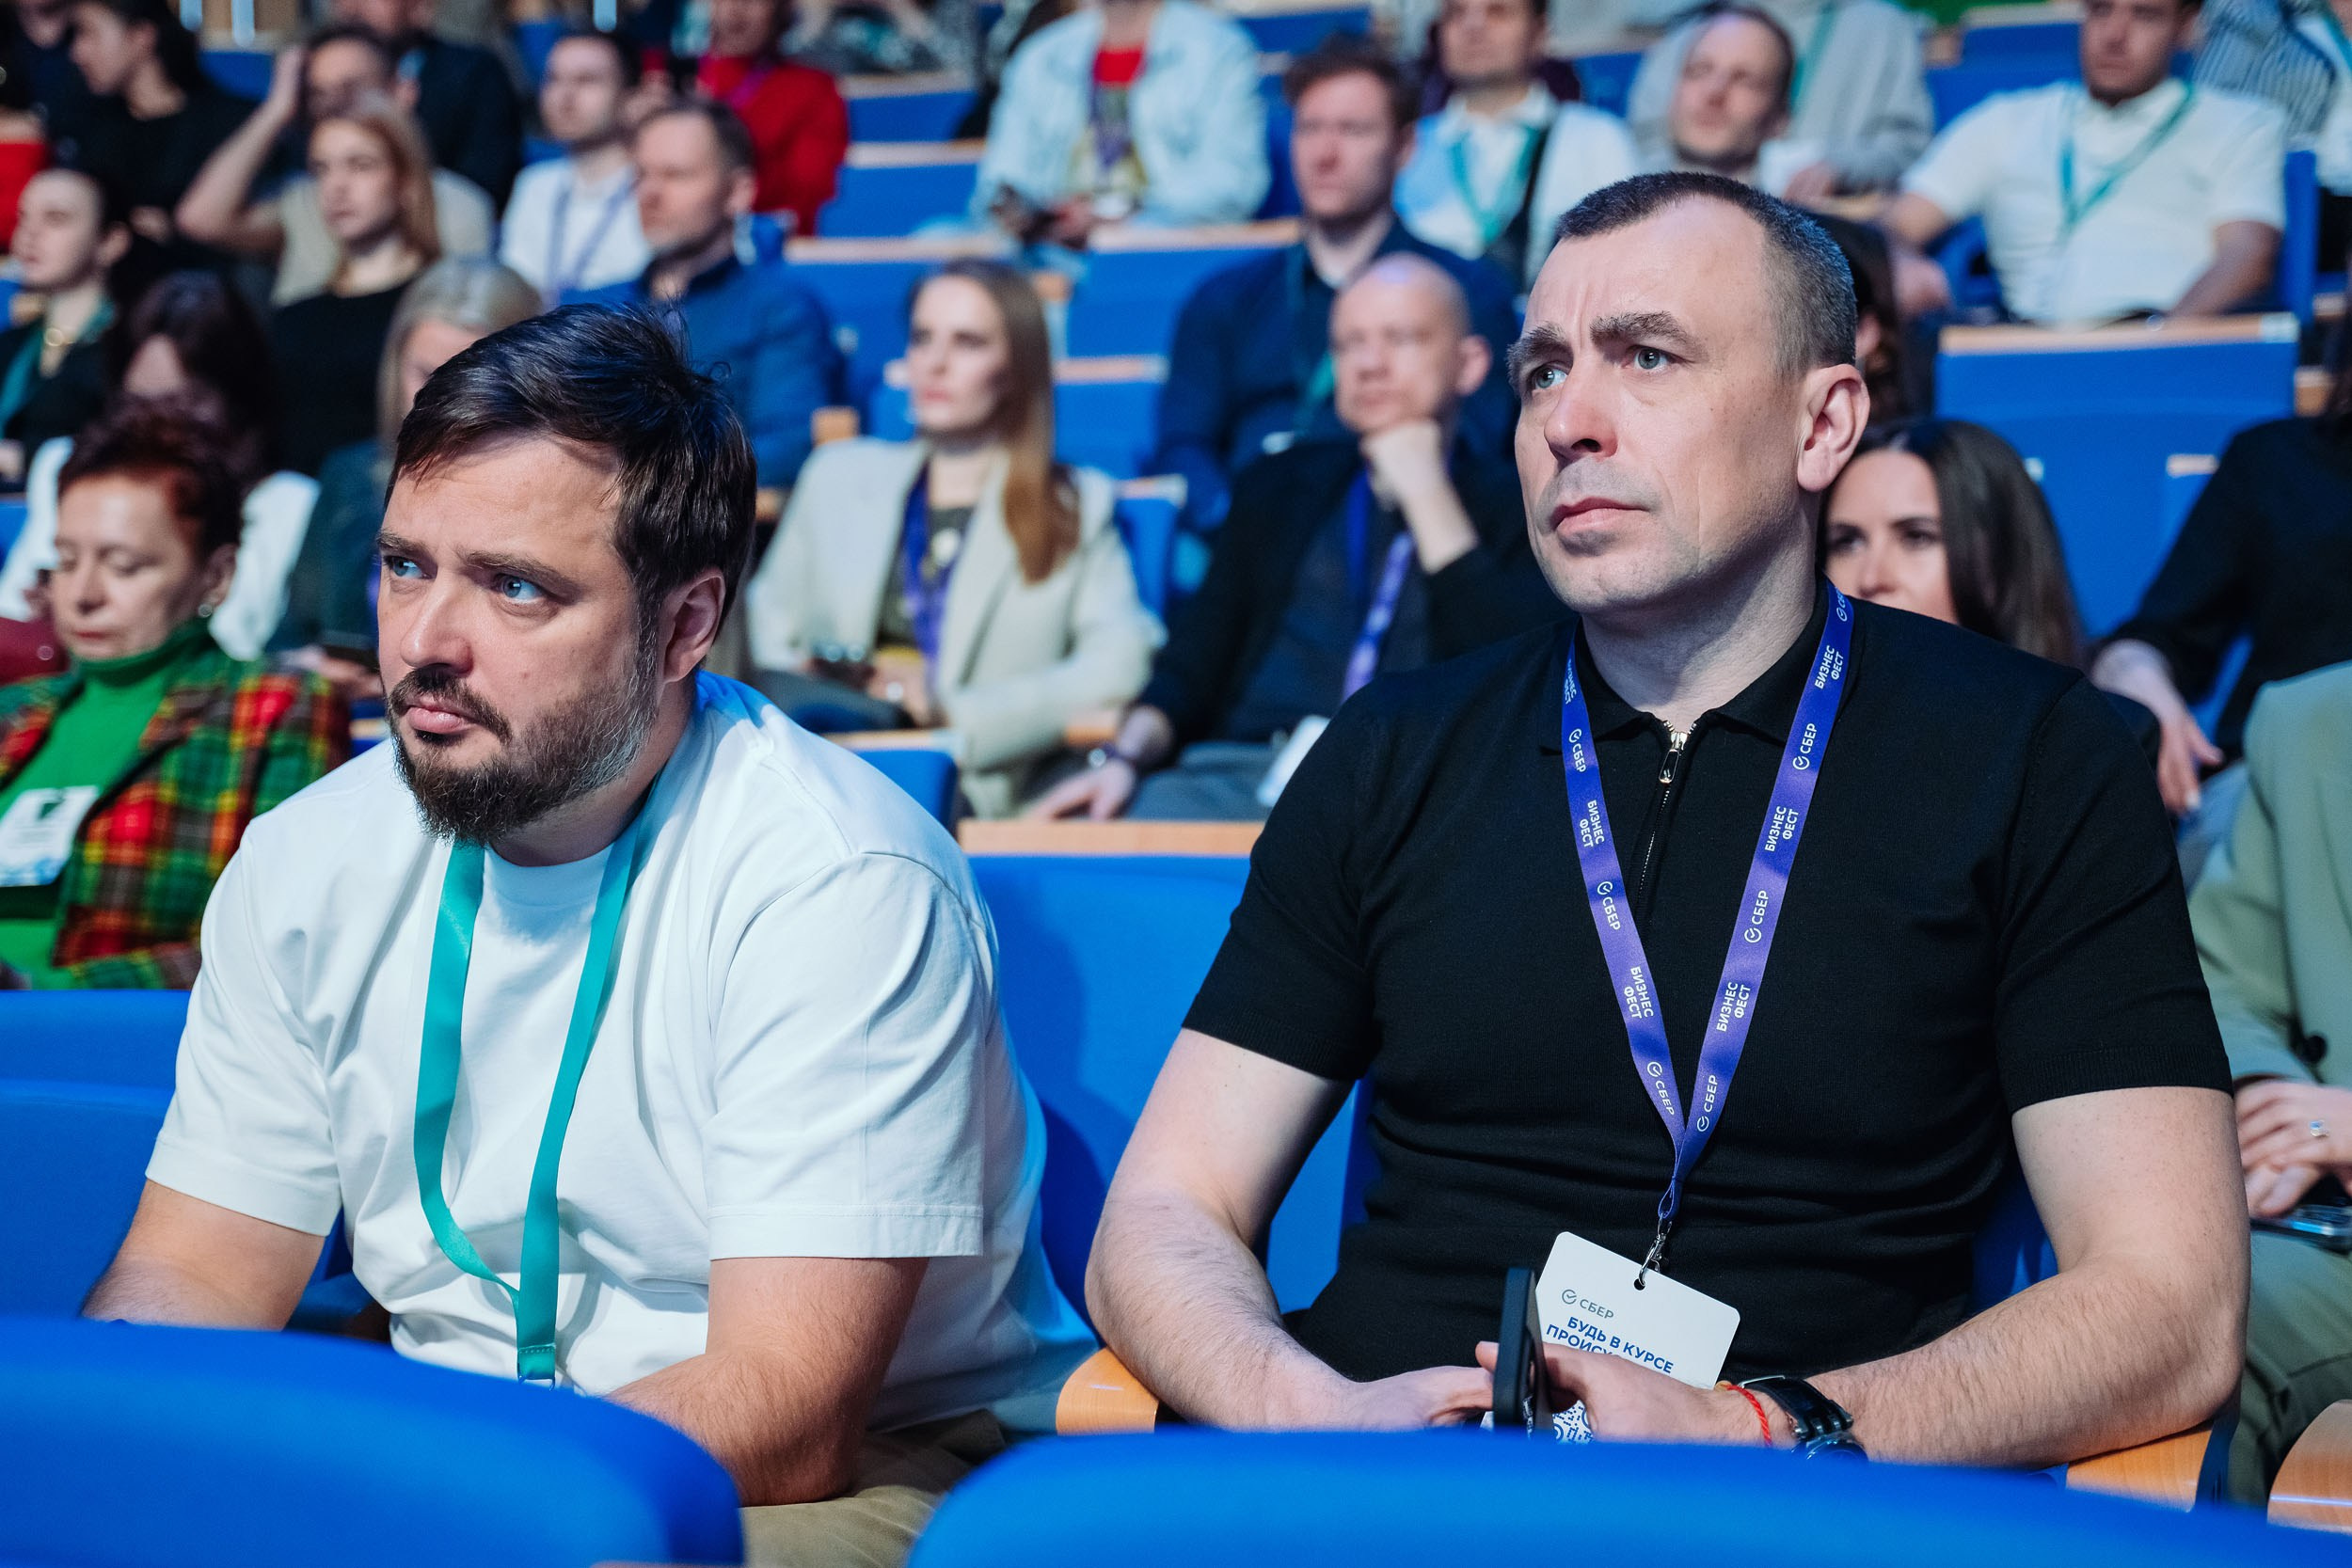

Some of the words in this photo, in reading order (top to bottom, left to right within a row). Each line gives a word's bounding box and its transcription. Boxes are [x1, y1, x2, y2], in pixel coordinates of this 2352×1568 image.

[1815, 644, 1835, 689] БИЗНЕС
[1831, 652, 1844, 680] ФЕСТ
[1801, 722, 1817, 754] СБЕР
[1571, 743, 1586, 773] СБЕР
[1579, 818, 1594, 848] ФЕСТ
[1587, 800, 1605, 844] БИЗНЕС
[1765, 806, 1787, 852] БИЗНЕС
[1782, 809, 1799, 840] ФЕСТ
[1602, 896, 1621, 930] СБЕР
[1751, 890, 1769, 925] СБЕР
[1624, 986, 1642, 1019] ФЕСТ
[1630, 966, 1654, 1018] БИЗНЕС
[1716, 982, 1739, 1032] БИЗНЕС
[1734, 984, 1751, 1019] ФЕСТ
[1655, 1081, 1675, 1116] СБЕР
[1704, 1075, 1718, 1113] СБЕР
[1580, 1298, 1614, 1320] СБЕР
[1567, 1316, 1607, 1342] БУДЬ
[1610, 1336, 1621, 1349] В
[1623, 1342, 1674, 1373] КУРСЕ
